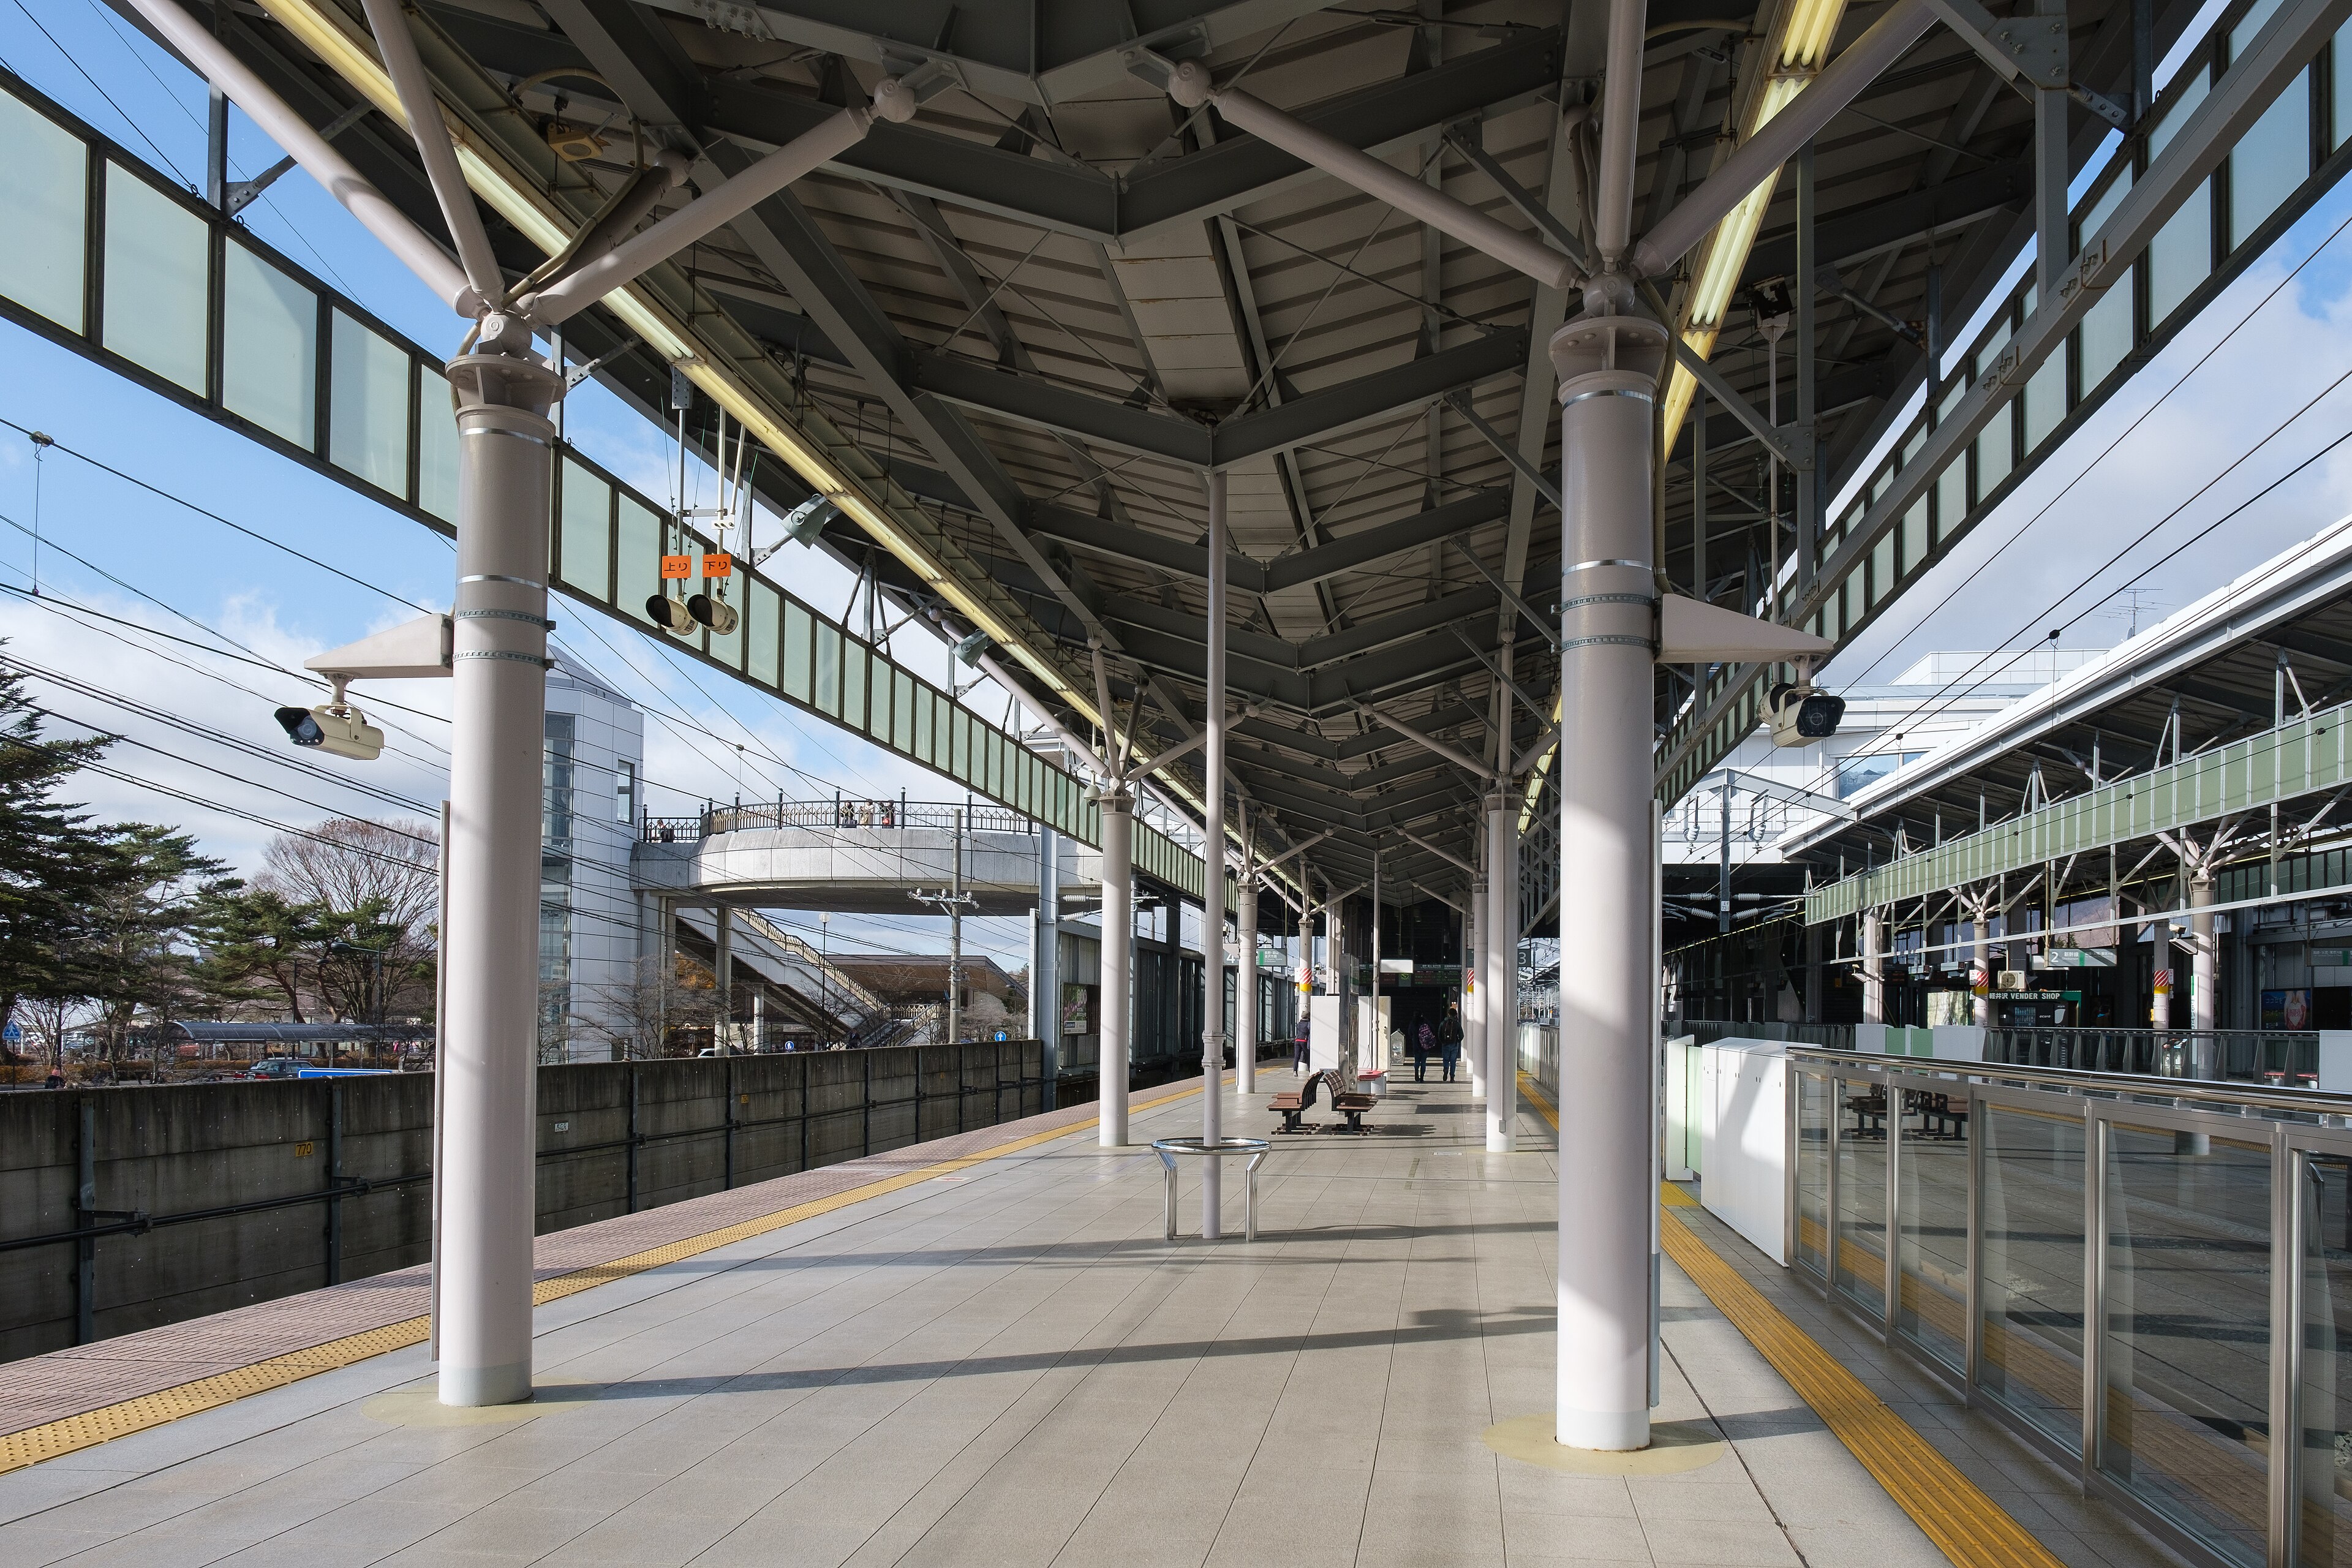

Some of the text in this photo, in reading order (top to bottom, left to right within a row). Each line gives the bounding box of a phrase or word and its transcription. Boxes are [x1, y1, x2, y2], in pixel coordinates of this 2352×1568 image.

[664, 562, 688, 571] 上り
[704, 560, 728, 571] 下り
[1226, 954, 1235, 963] 4
[1518, 952, 1526, 965] 3
[2051, 951, 2059, 962] 2
[296, 1142, 312, 1156] 770
